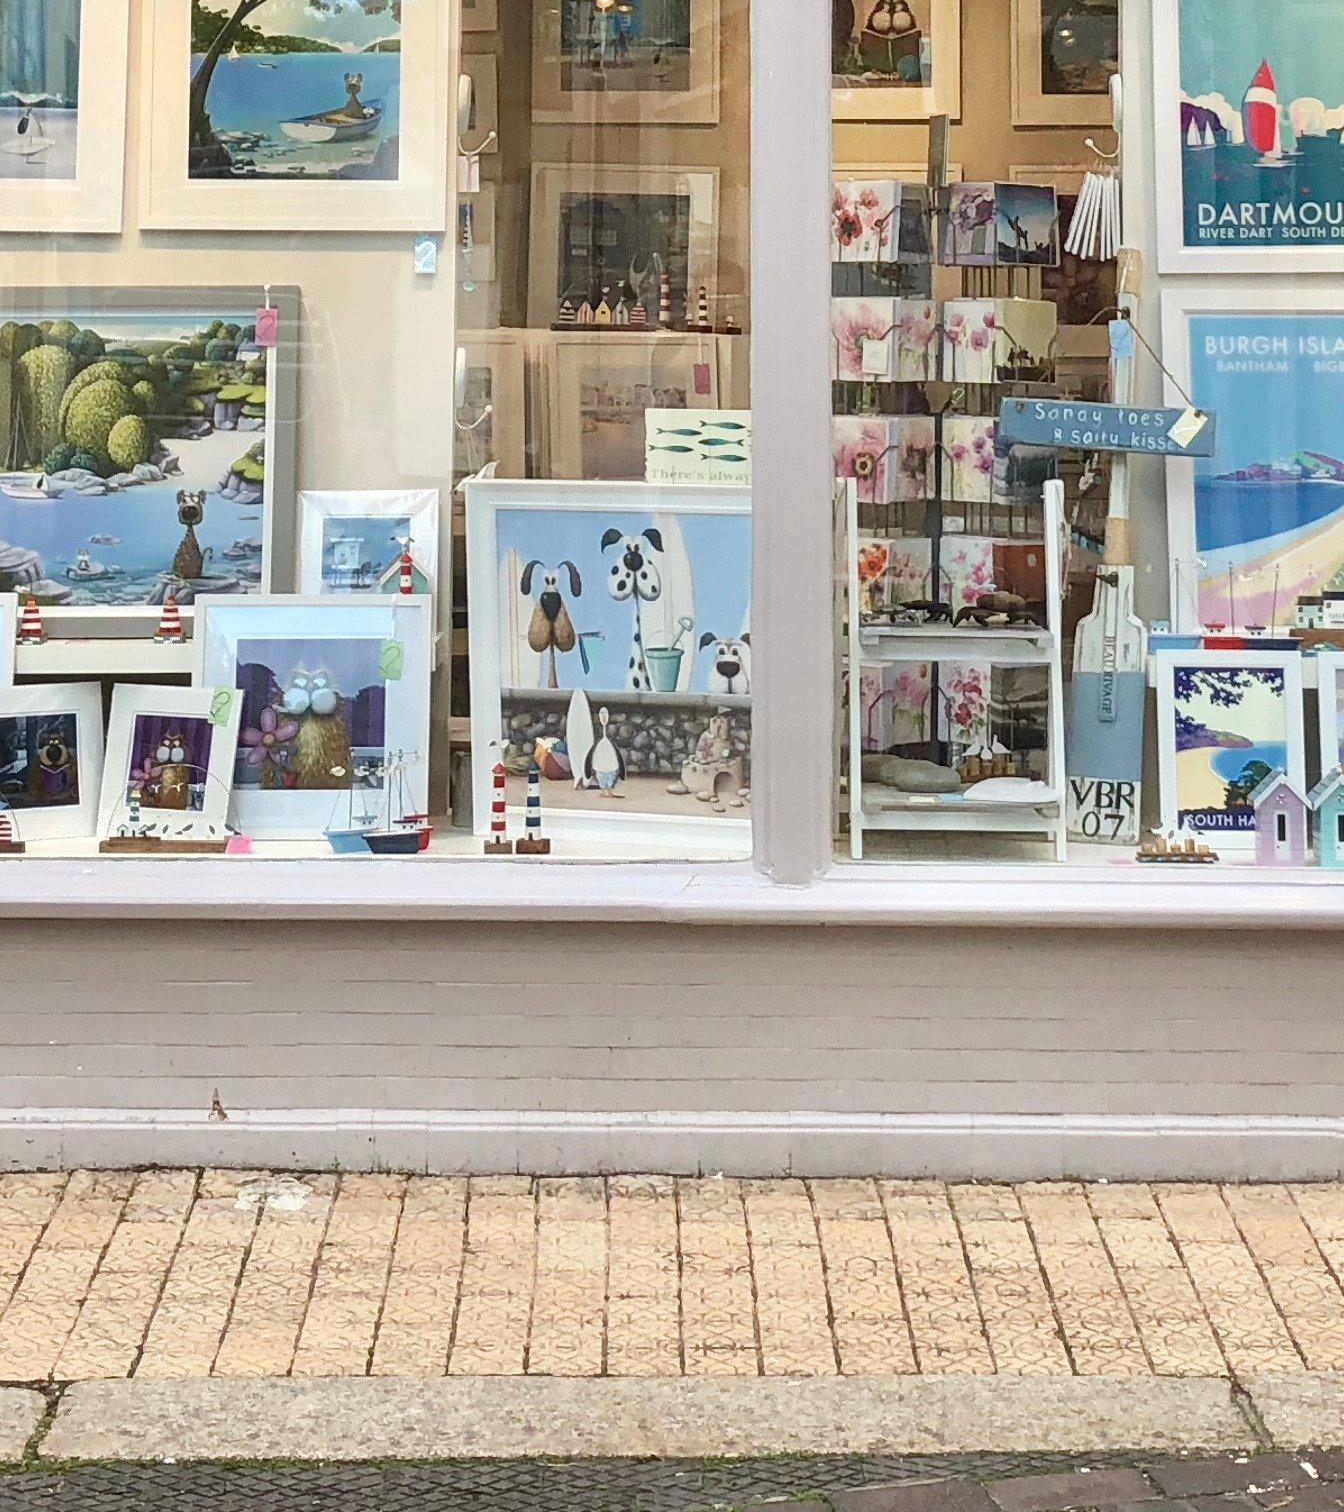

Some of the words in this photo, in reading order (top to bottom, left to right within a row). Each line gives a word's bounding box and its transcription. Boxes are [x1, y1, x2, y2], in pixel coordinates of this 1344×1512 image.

[1198, 227, 1235, 239] RIVER
[1239, 227, 1273, 239] DART
[1281, 226, 1327, 238] SOUTH
[1205, 335, 1288, 355] BURGH
[1216, 360, 1289, 372] BANTHAM
[1118, 408, 1165, 427] toes
[709, 469, 751, 483] alway
[1070, 779, 1136, 810] VBR
[1081, 810, 1125, 841] 07
[1237, 814, 1256, 827] HA
